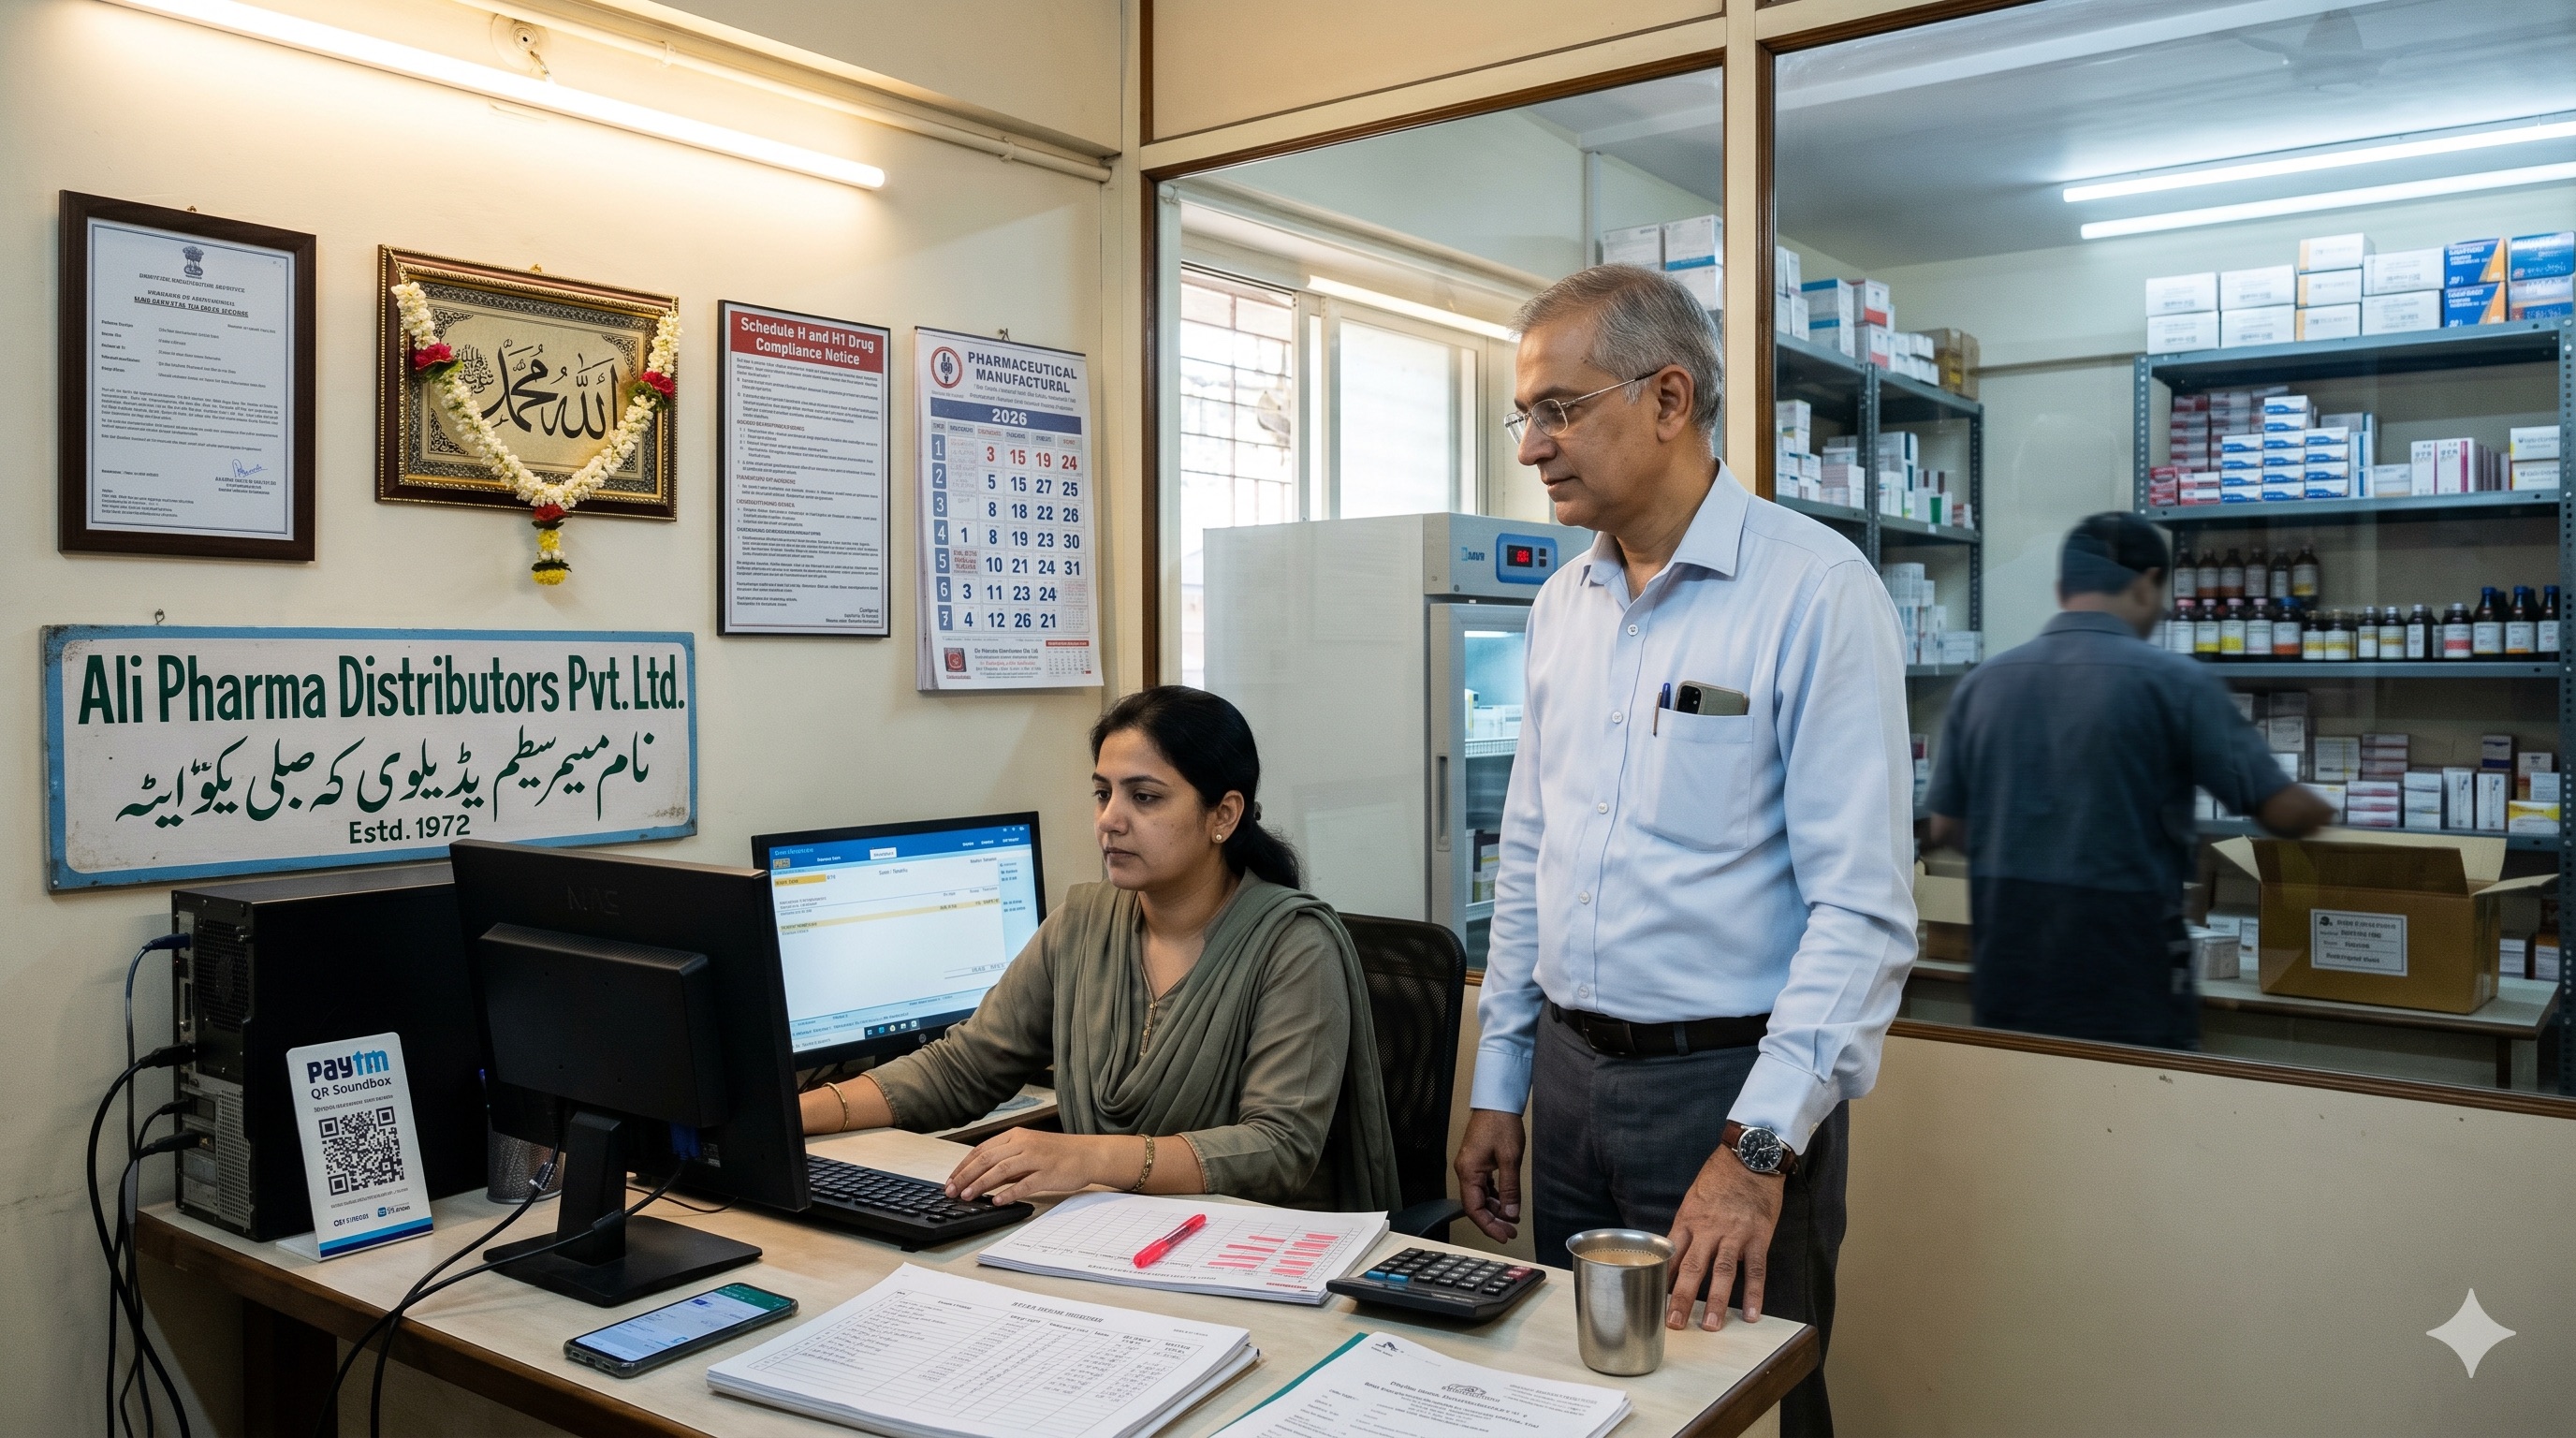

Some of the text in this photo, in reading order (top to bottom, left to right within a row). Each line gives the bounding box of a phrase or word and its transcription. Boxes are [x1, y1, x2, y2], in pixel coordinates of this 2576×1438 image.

[740, 316, 874, 355] Schedule H and H1 Drug
[755, 337, 822, 360] Compliance
[968, 351, 1077, 380] PHARMACEUTICAL
[975, 368, 1071, 394] MANUFACTURAL
[991, 407, 1028, 426] 2026
[935, 440, 1078, 471] 1 3 15 19 24
[935, 468, 1078, 497] 2 5 15 27 25
[936, 496, 1079, 523] 3 8 18 22 26
[937, 524, 1080, 550] 4 1 8 19 23 30
[939, 553, 947, 569] 5
[986, 556, 1003, 573] 10
[1011, 558, 1028, 574] 21
[1037, 559, 1056, 575] 24
[1064, 560, 1080, 576] 31
[940, 581, 1057, 602] 6 3 11 23 24
[963, 611, 973, 627] 4
[988, 612, 1005, 628] 12
[1014, 612, 1032, 628] 26
[1040, 612, 1056, 628] 21
[78, 654, 685, 726] Ali Pharma Distributors Pvt. Ltd.
[349, 814, 472, 844] Estd. 1972
[311, 1077, 393, 1102] QR Soundbox
